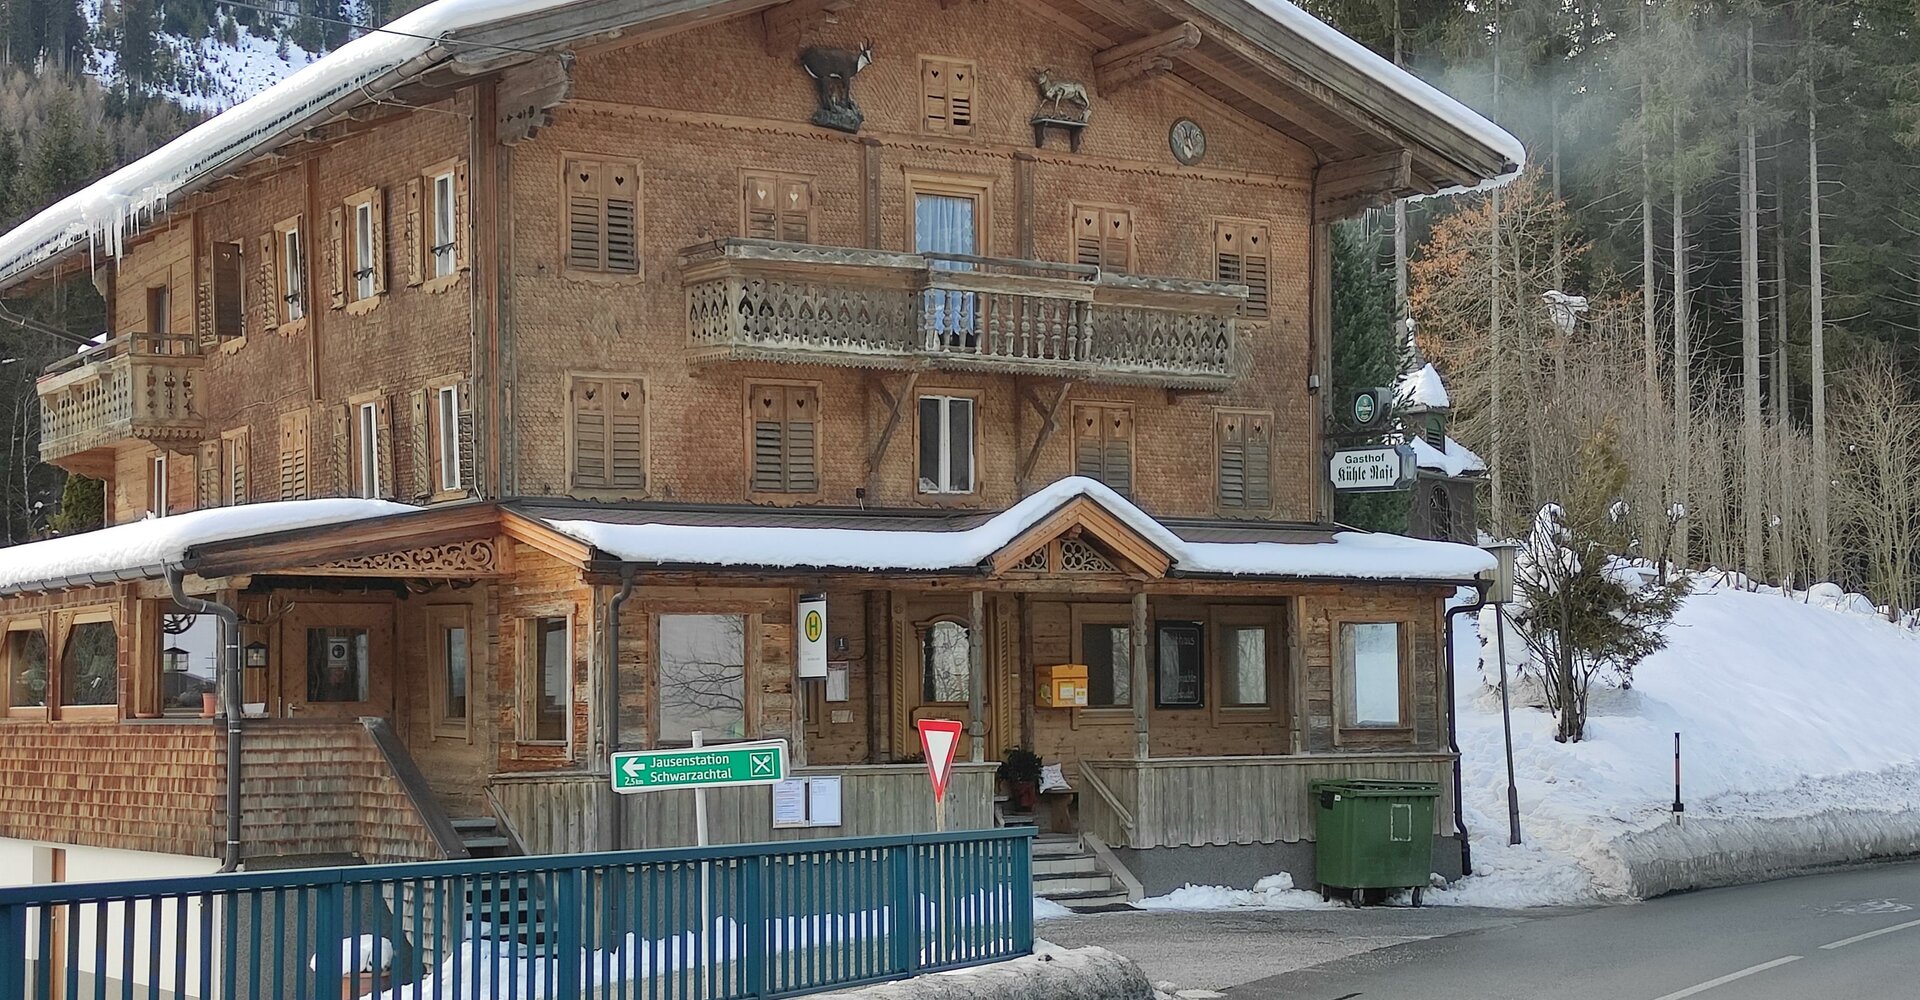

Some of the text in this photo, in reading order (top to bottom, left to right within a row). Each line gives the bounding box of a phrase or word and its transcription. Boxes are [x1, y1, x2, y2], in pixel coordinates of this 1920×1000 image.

[1345, 453, 1385, 464] Gasthof
[1337, 466, 1366, 485] Kühle
[809, 616, 818, 636] H
[650, 753, 730, 768] Jausenstation
[650, 767, 732, 783] Schwarzachtal
